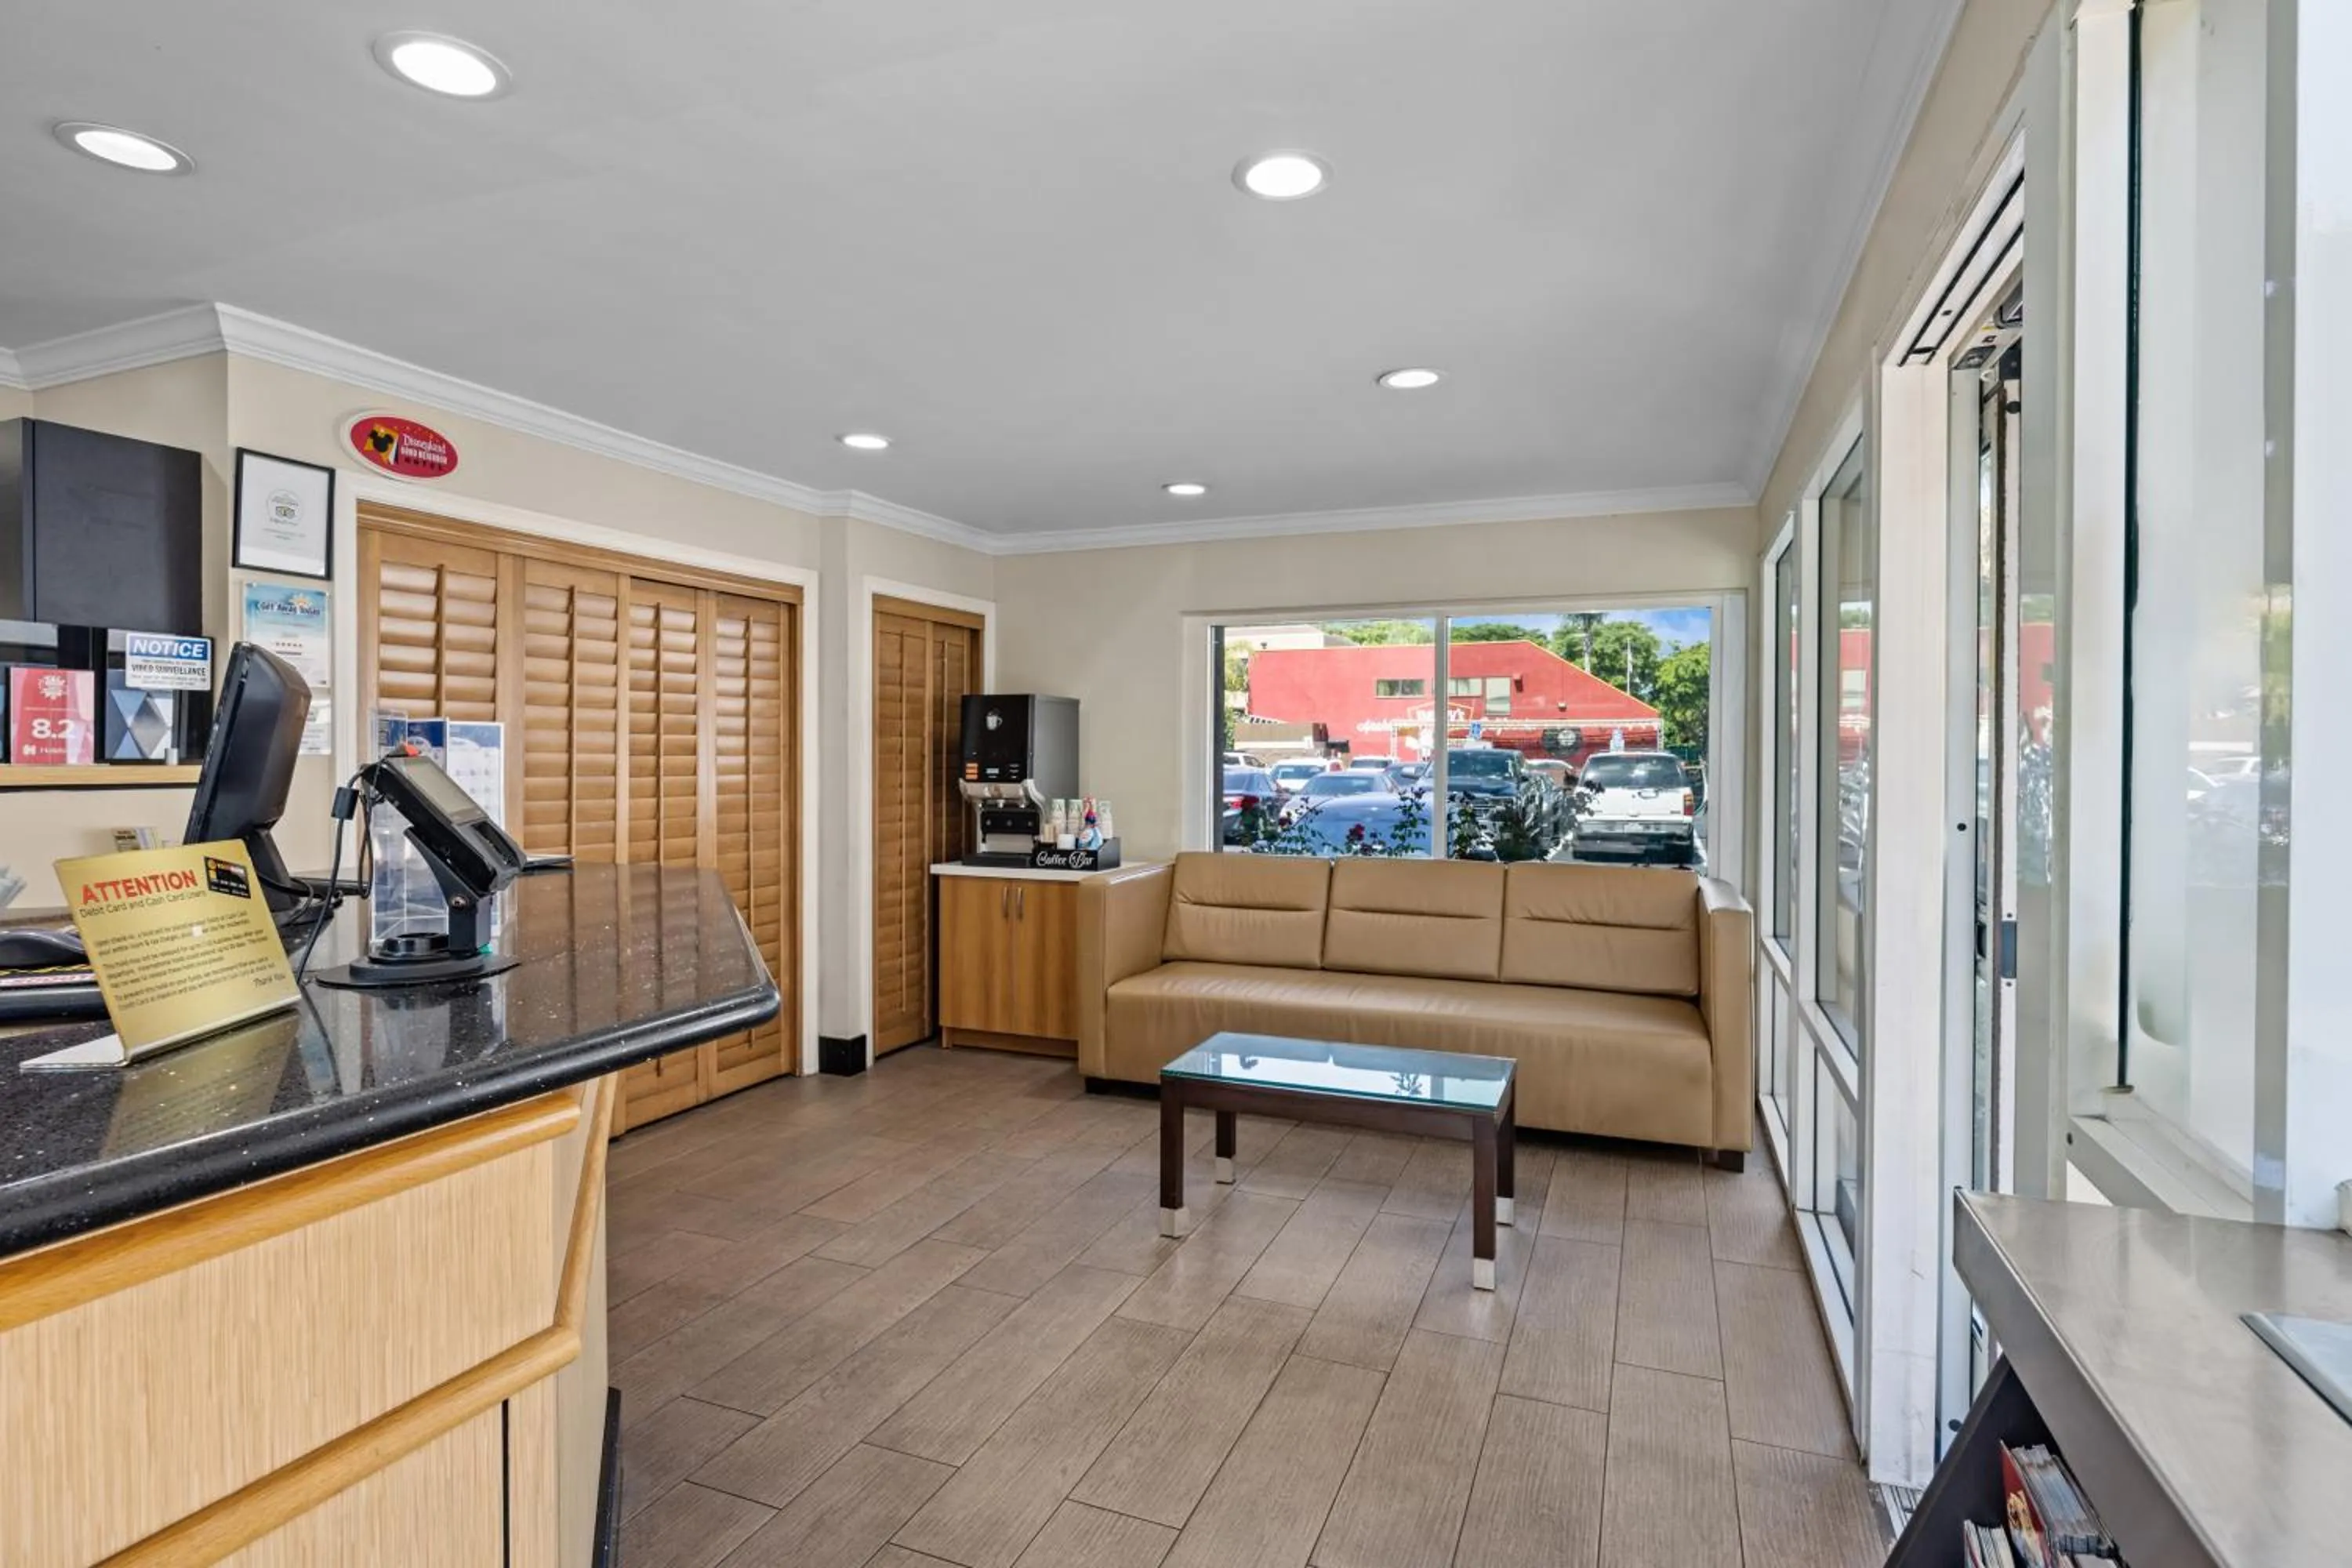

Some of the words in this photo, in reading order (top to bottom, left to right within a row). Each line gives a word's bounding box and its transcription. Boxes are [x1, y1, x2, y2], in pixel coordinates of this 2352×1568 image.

[402, 433, 446, 454] Disneyland
[133, 639, 205, 659] NOTICE
[32, 718, 75, 739] 8.2
[1036, 851, 1067, 866] Coffee
[1069, 851, 1094, 869] Bar
[82, 869, 198, 905] ATTENTION
[79, 906, 105, 918] Debit
[106, 903, 128, 913] Card
[129, 899, 144, 910] and
